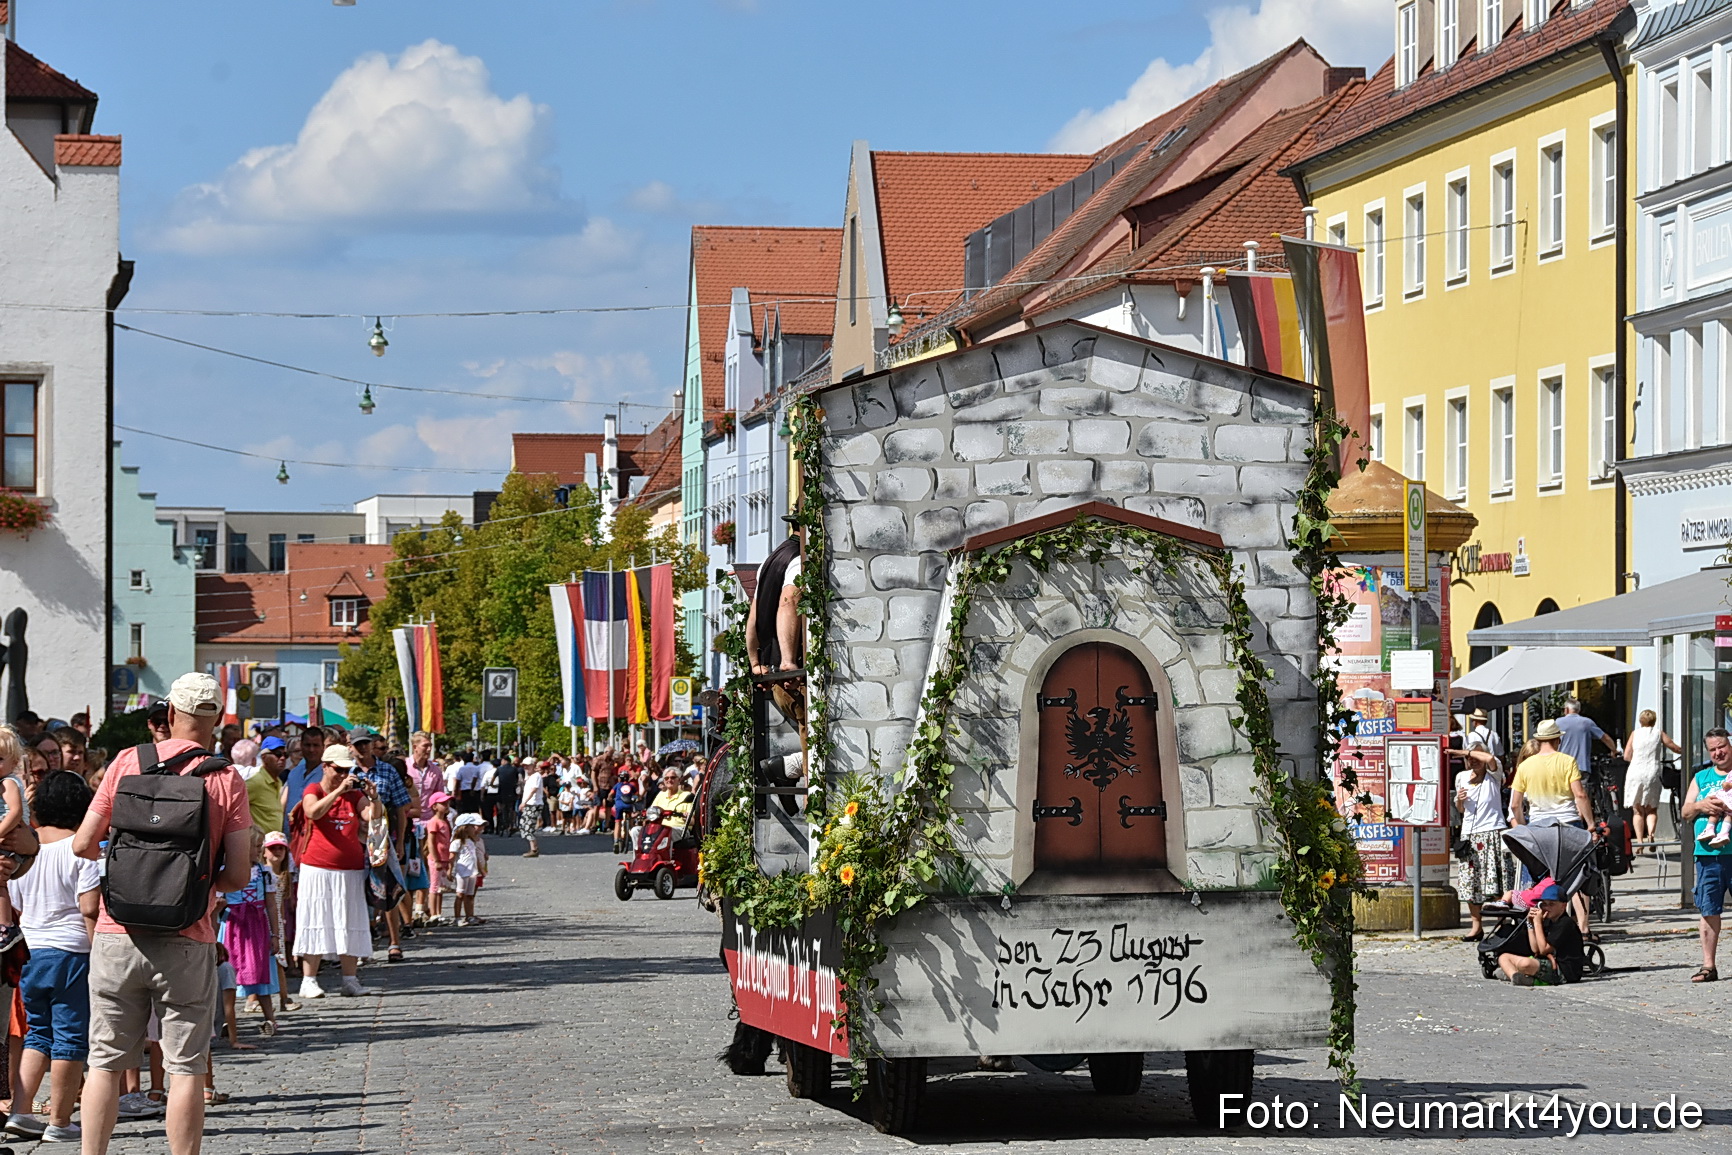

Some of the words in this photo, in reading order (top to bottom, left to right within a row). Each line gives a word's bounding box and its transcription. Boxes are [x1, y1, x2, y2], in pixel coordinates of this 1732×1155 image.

[998, 934, 1042, 965] den
[1051, 928, 1102, 967] 23
[1110, 923, 1204, 969] August
[992, 968, 1018, 1009] in
[1021, 966, 1112, 1024] Jahr
[1128, 965, 1208, 1020] 1796
